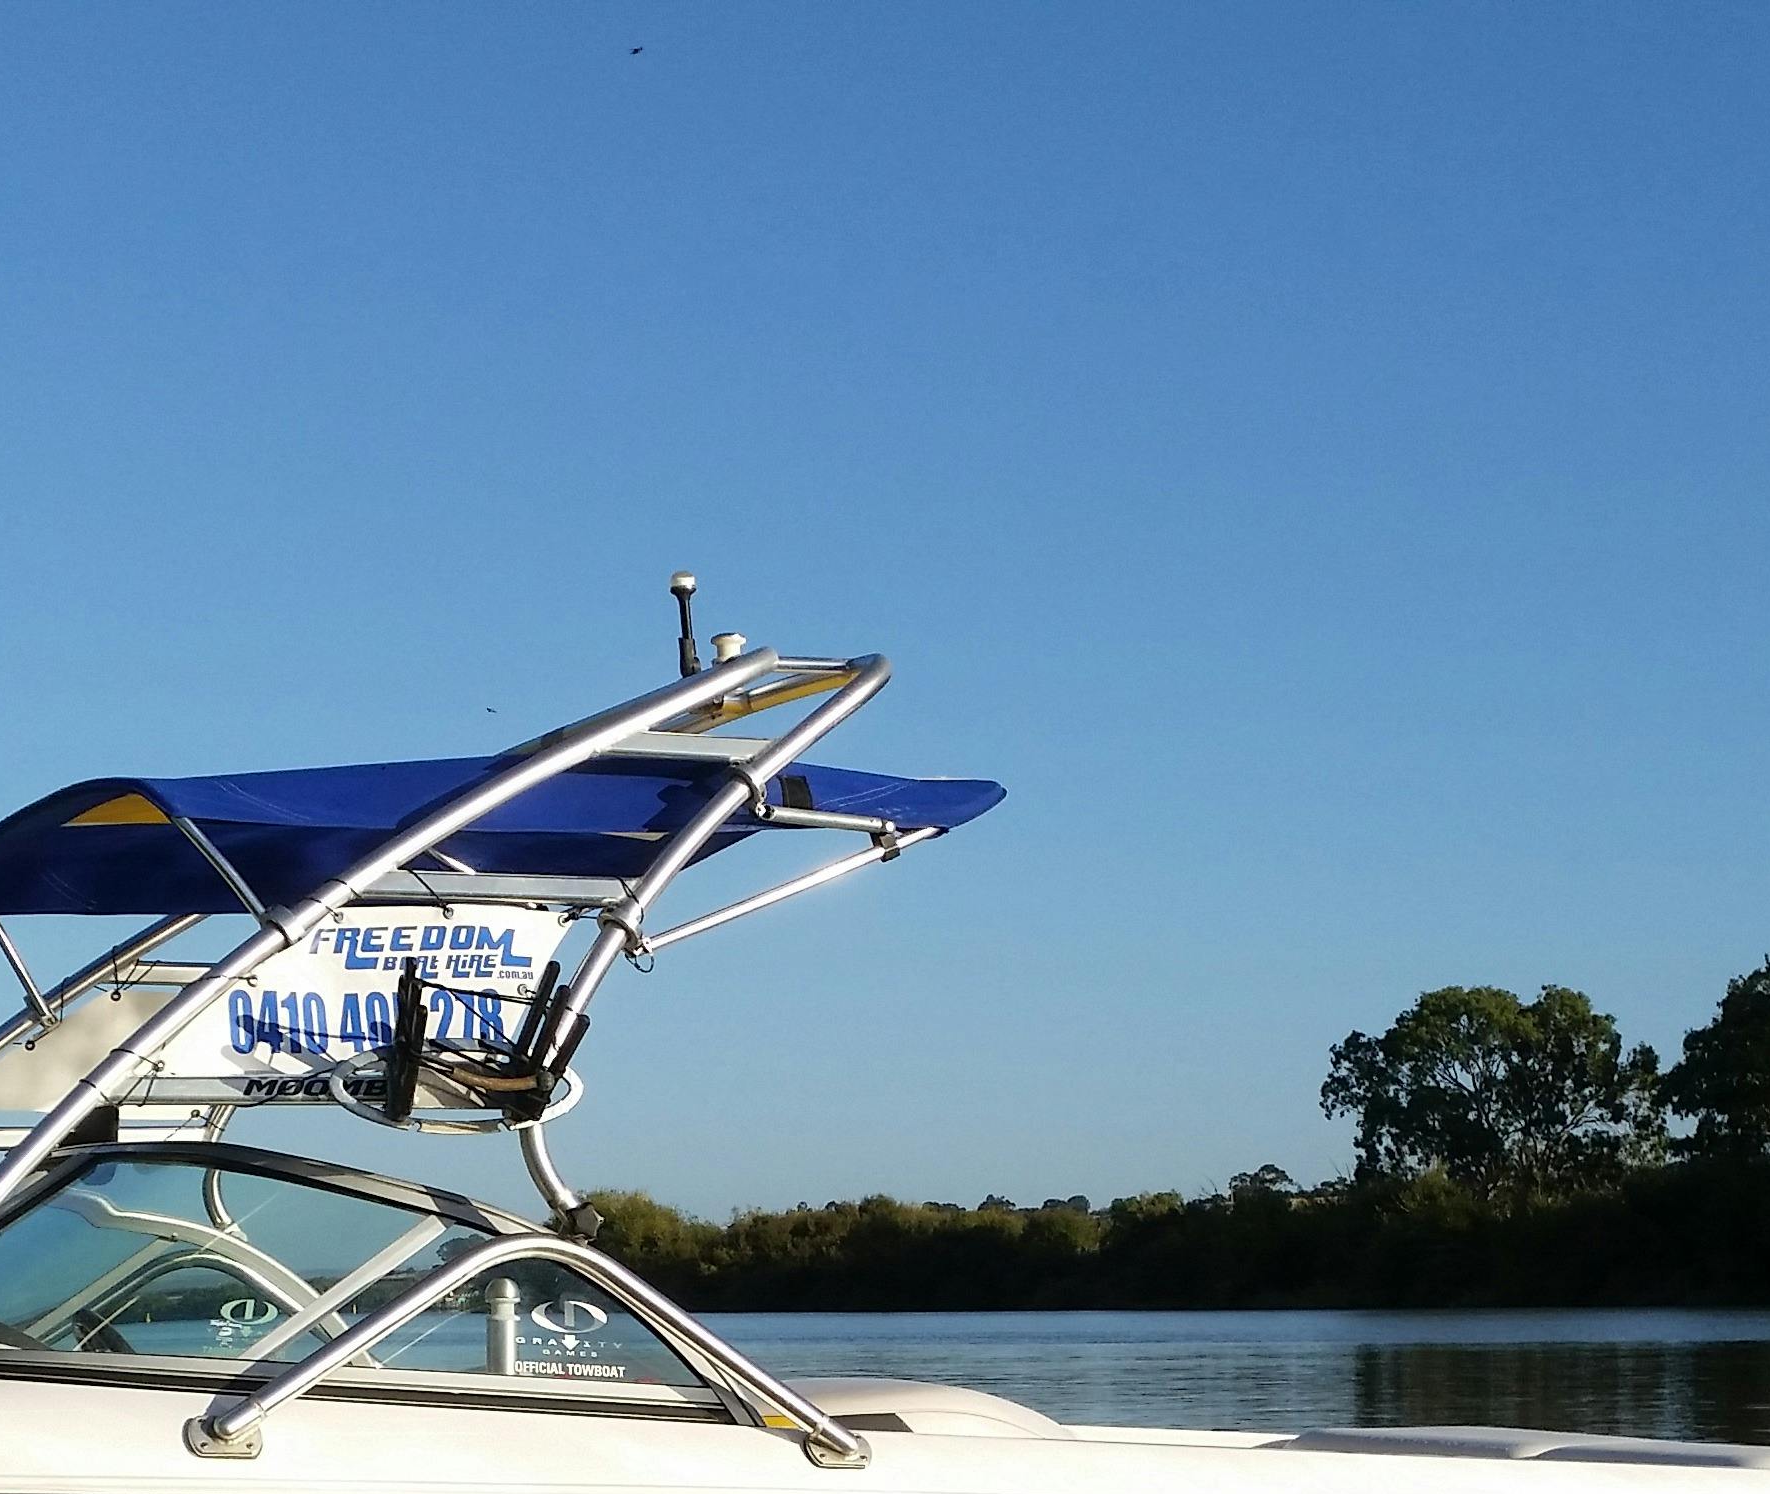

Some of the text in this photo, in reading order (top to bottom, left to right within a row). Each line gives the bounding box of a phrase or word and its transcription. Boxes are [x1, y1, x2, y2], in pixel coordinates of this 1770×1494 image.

[309, 926, 533, 970] FREEDOM
[228, 988, 505, 1055] 0410 40 278
[243, 1079, 388, 1096] MOOMB
[542, 1349, 598, 1358] GAMES
[515, 1361, 626, 1378] OFFICIAL TOWBOAT
